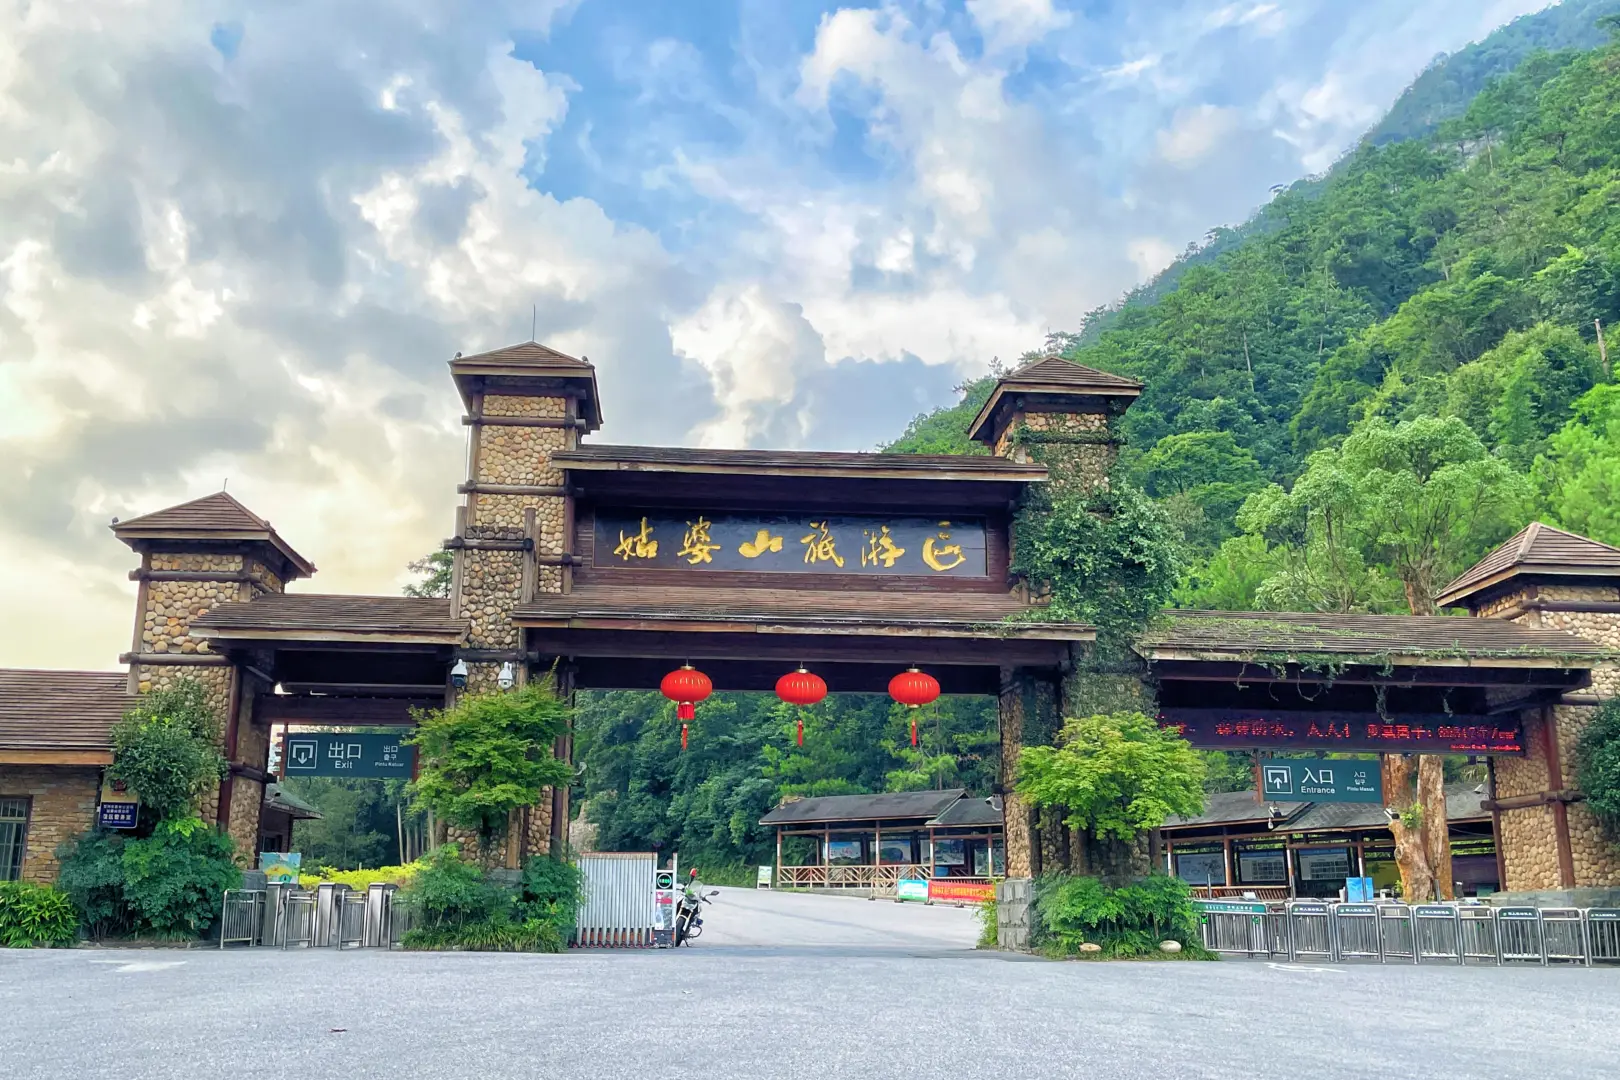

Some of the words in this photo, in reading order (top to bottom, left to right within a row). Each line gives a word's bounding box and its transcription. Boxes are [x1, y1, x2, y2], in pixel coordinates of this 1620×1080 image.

[328, 742, 362, 759] 出口
[383, 745, 398, 753] 出口
[334, 760, 353, 769] Exit
[1301, 767, 1334, 785] 入口
[1301, 786, 1335, 794] Entrance
